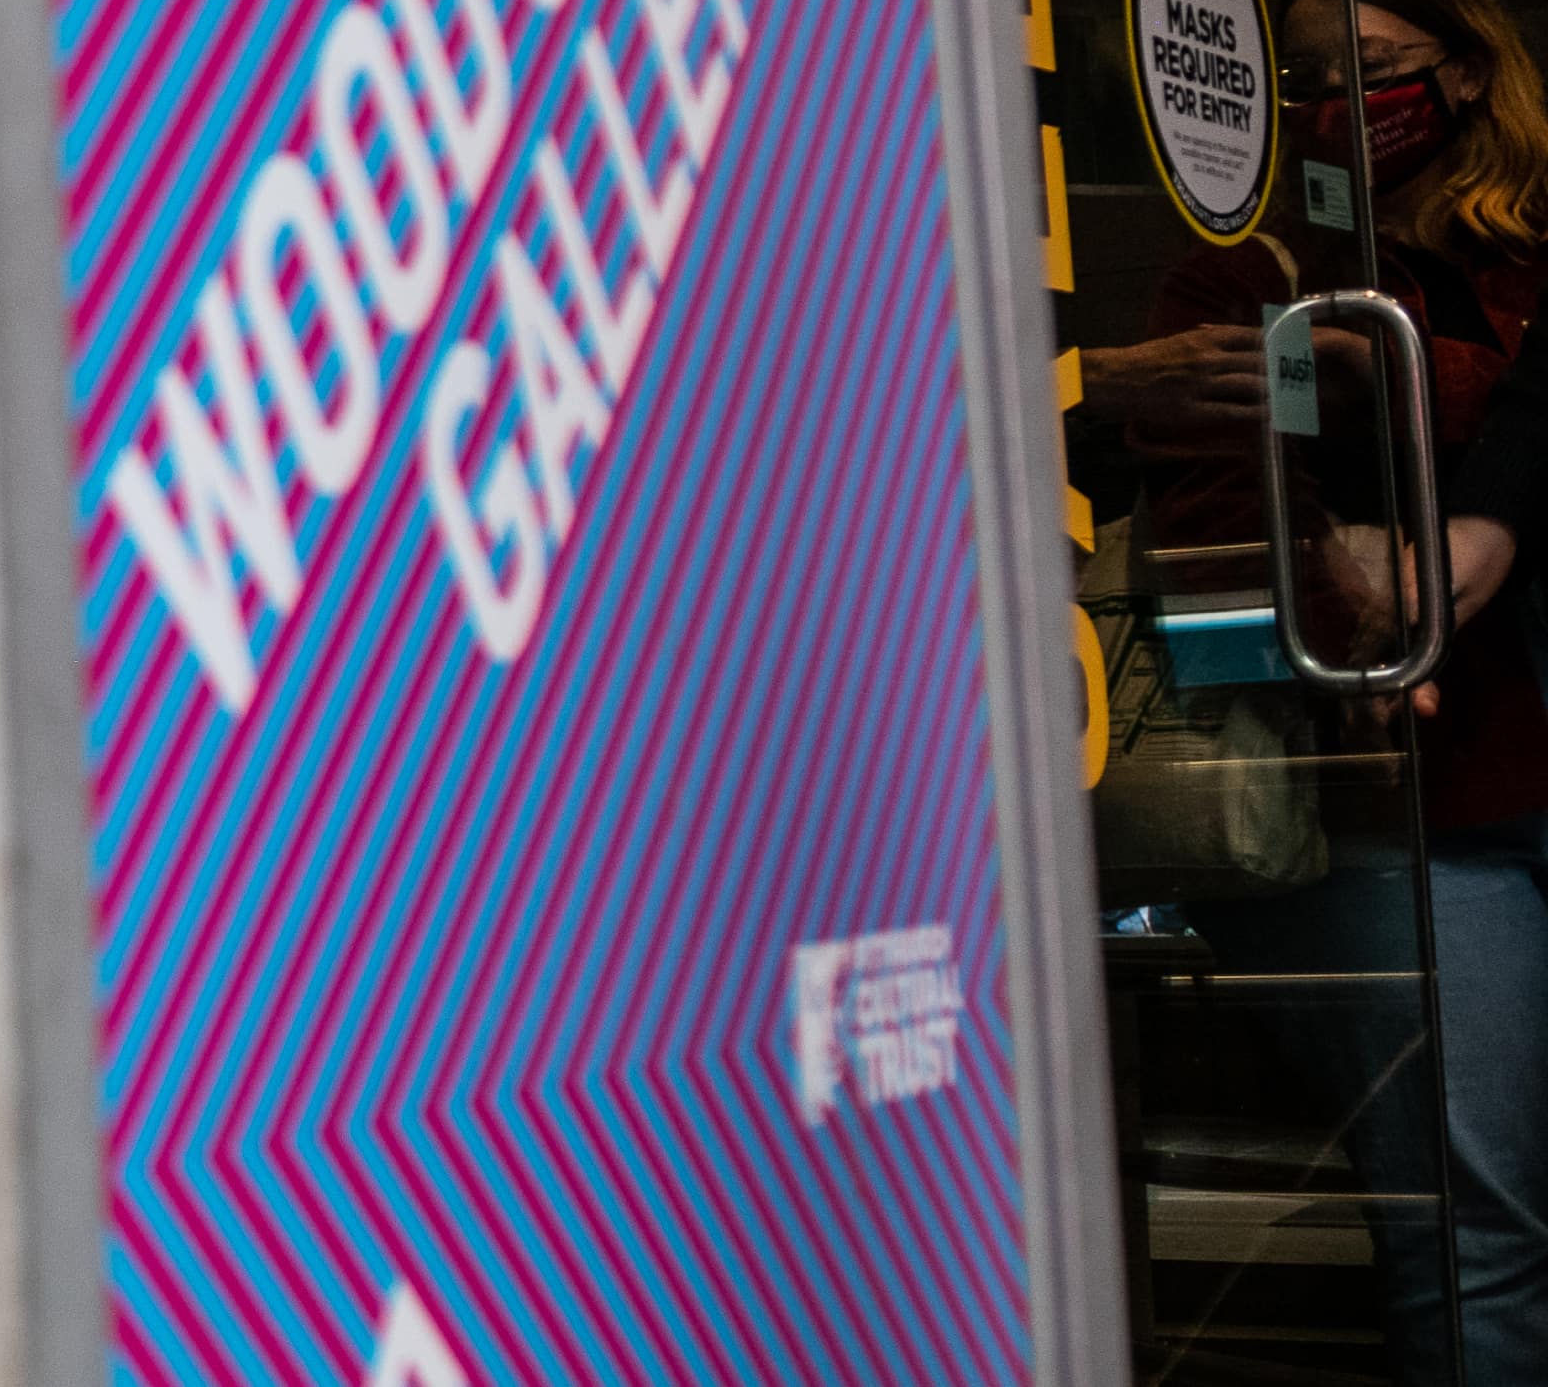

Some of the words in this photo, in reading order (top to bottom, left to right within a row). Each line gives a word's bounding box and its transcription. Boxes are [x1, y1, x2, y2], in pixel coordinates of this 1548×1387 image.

[1151, 35, 1256, 99] REQUIRED
[1162, 80, 1198, 119] FOR
[1200, 91, 1253, 133] ENTRY
[859, 1017, 959, 1105] TRUST
